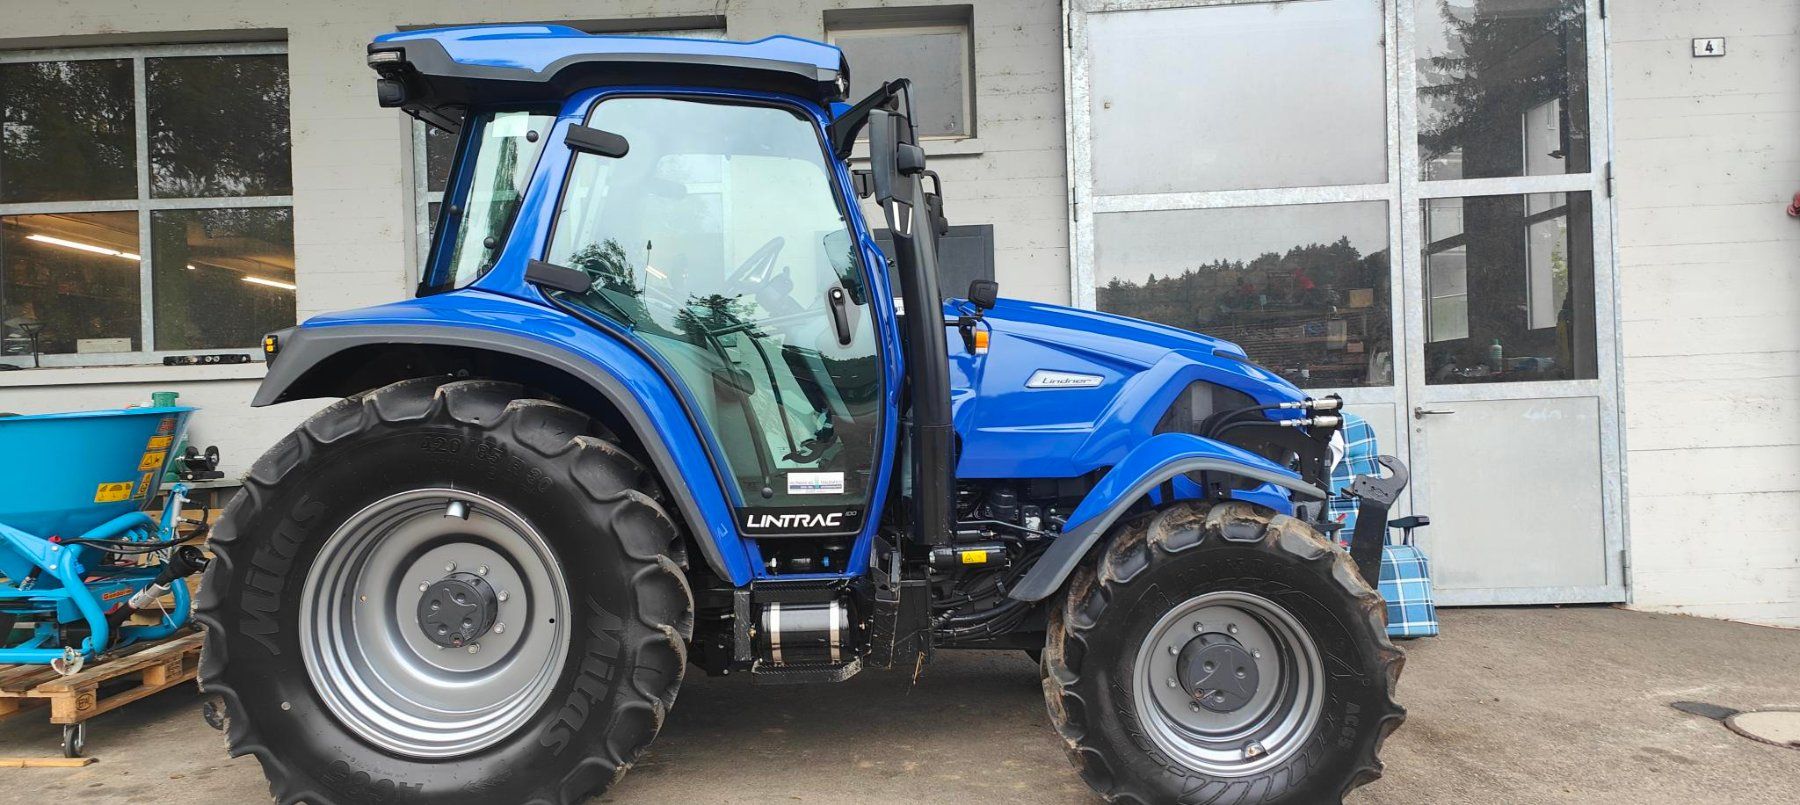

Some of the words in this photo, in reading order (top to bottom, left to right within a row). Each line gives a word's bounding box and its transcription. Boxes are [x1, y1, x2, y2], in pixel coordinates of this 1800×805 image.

[1705, 40, 1714, 54] 4
[746, 512, 843, 528] LINTRAC
[239, 494, 326, 656] Mitas
[540, 594, 622, 757] Mitas
